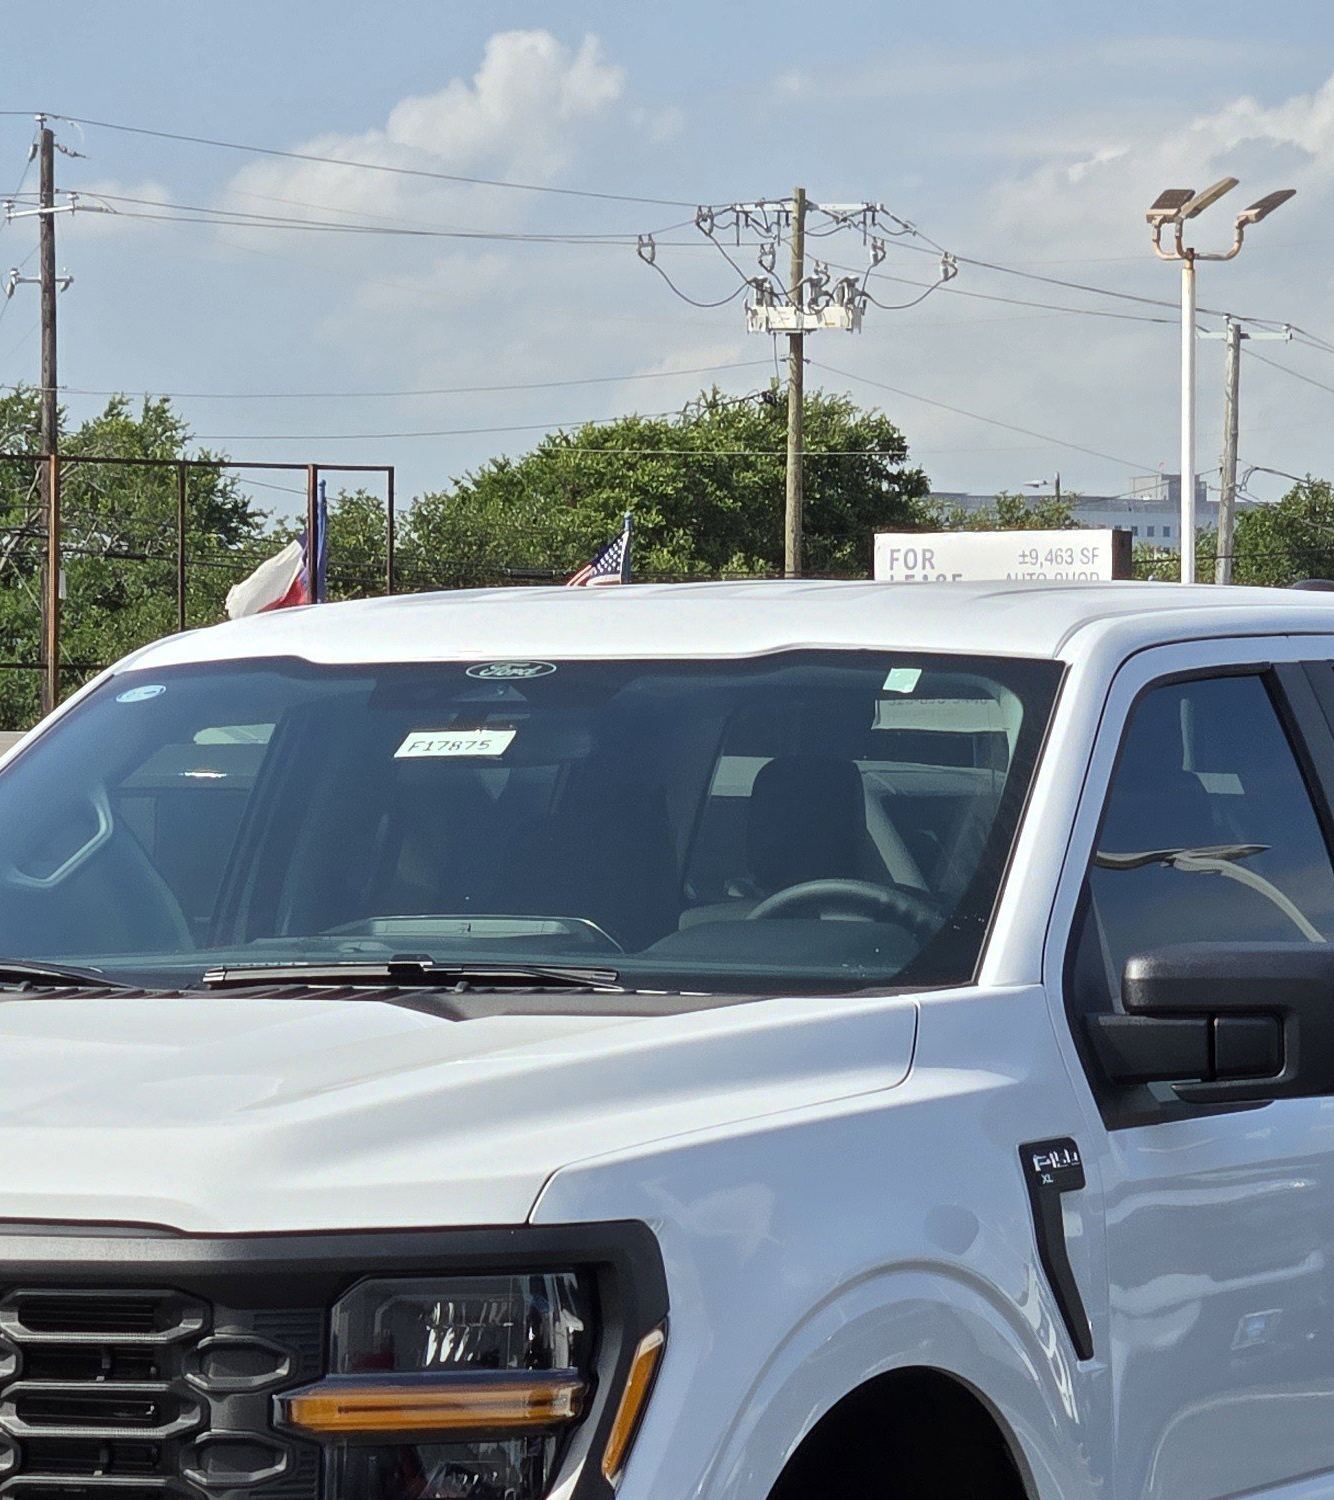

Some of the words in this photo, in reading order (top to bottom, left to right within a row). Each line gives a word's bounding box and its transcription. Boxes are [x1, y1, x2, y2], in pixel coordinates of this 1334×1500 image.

[889, 547, 935, 571] FOR
[1080, 547, 1100, 565] SF
[478, 661, 543, 677] Ford
[407, 739, 492, 753] F17875
